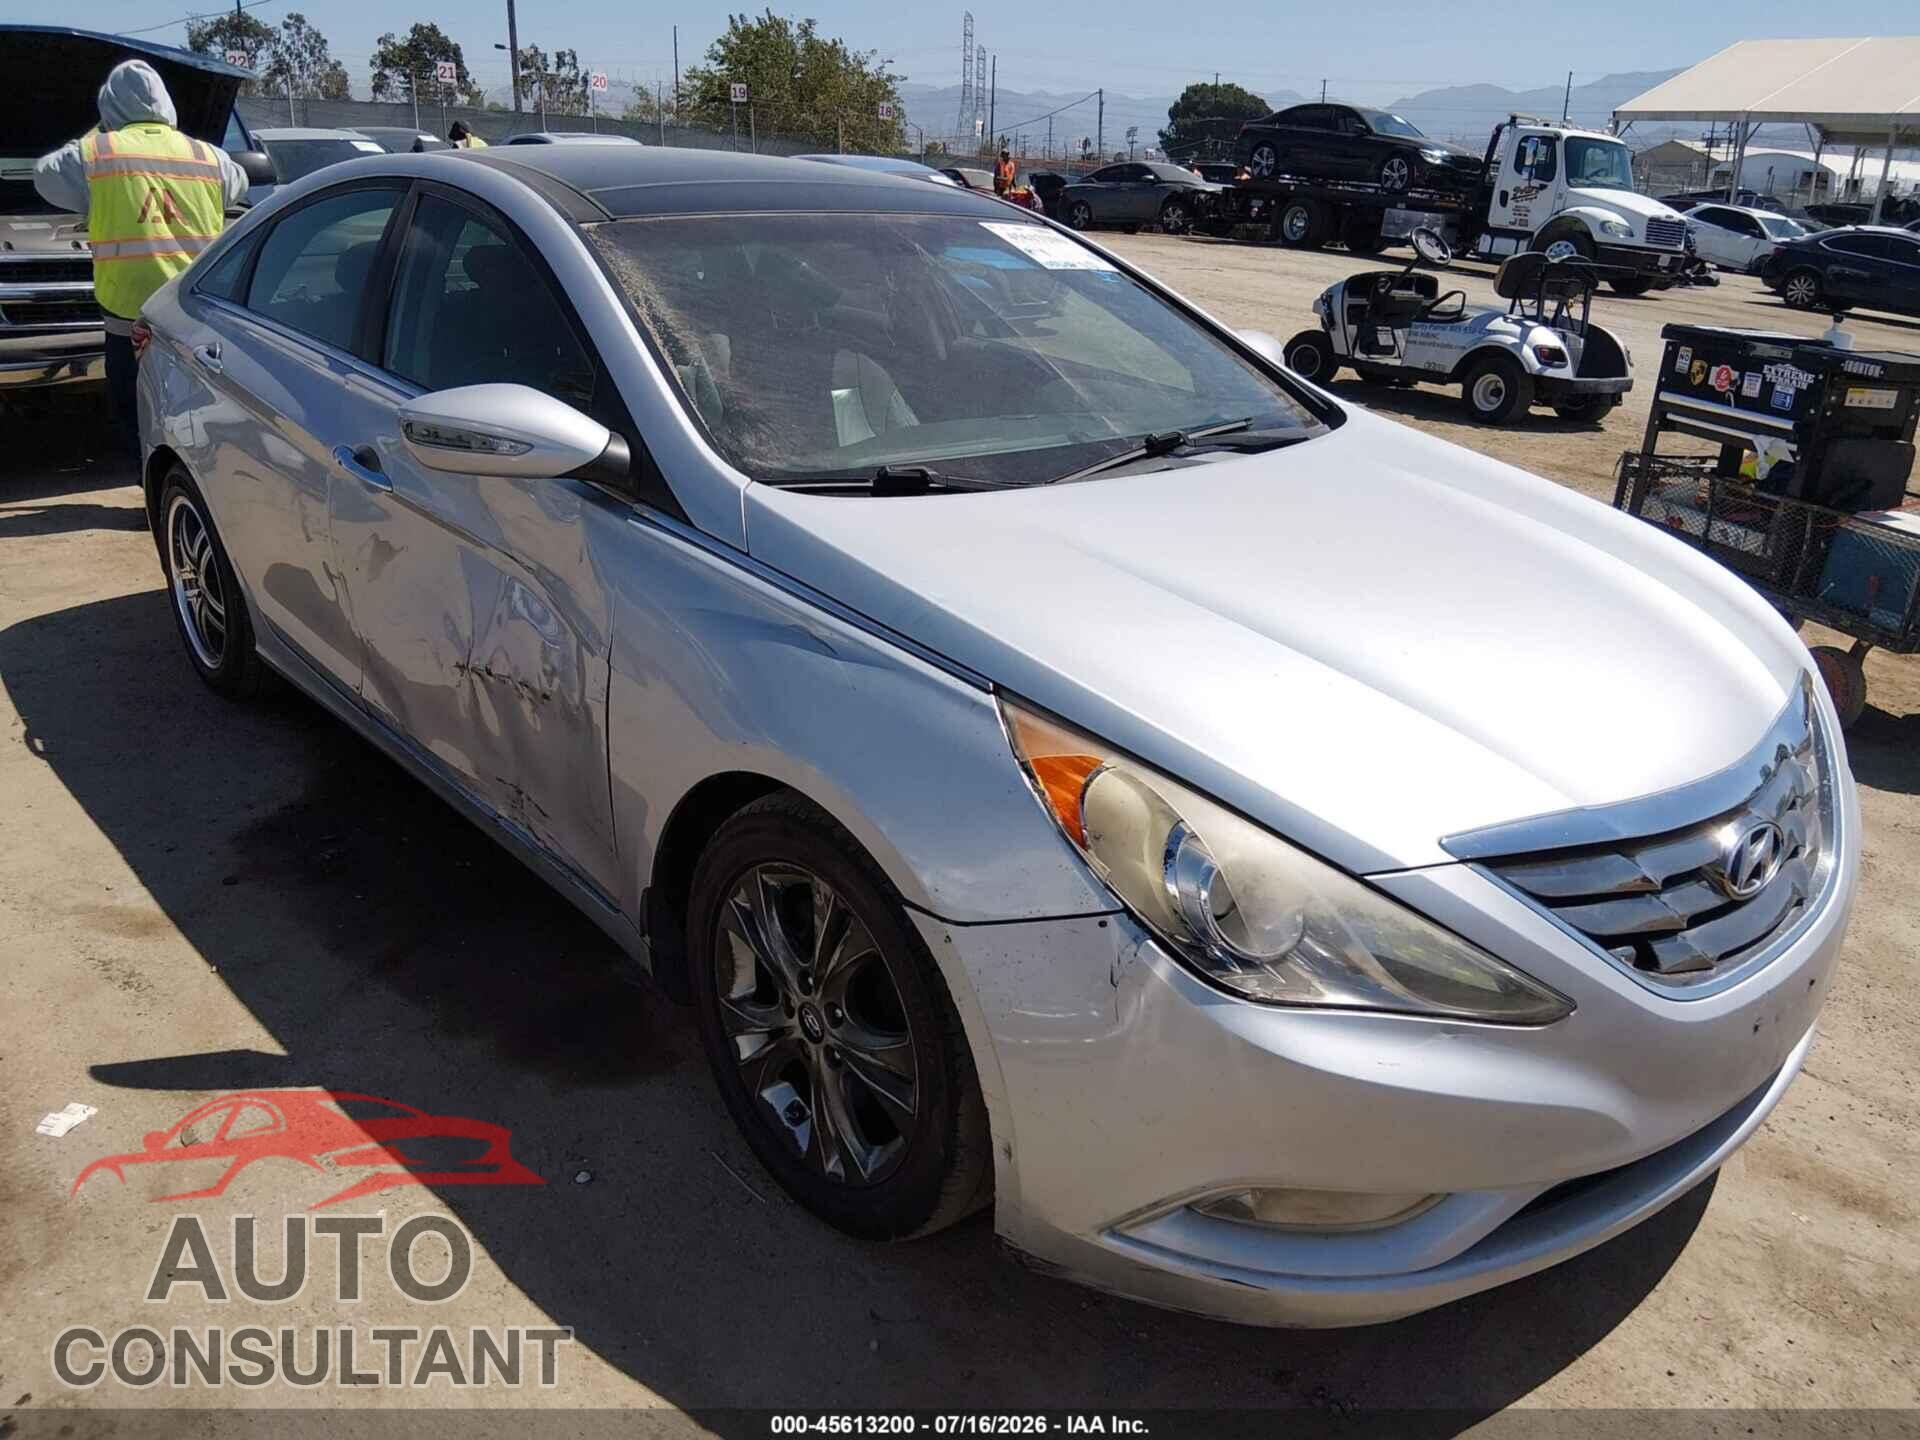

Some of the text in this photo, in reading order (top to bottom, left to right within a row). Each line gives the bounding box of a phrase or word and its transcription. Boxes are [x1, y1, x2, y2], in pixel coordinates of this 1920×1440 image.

[228, 55, 248, 68] 22
[439, 65, 456, 79] 21
[592, 75, 607, 89] 20
[731, 86, 746, 99] 19
[879, 105, 893, 117] 18
[1762, 364, 1816, 384] EXTREME
[1765, 374, 1809, 390] TERRAIN
